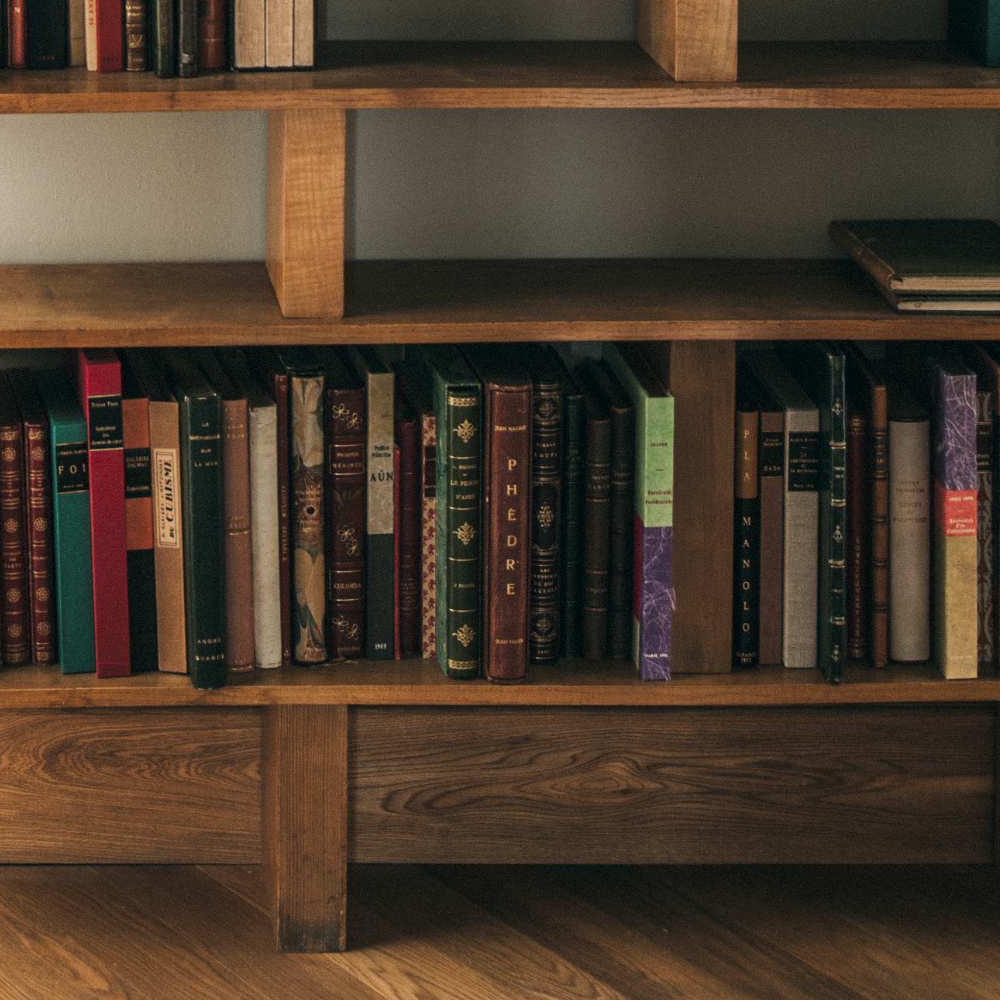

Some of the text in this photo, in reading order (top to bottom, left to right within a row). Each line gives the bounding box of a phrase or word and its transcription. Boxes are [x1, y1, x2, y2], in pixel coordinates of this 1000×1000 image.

[57, 463, 87, 476] FOI
[370, 470, 394, 482] AÚN
[743, 429, 751, 481] PLA
[163, 461, 174, 523] CUBISME
[742, 515, 751, 633] MANOLO
